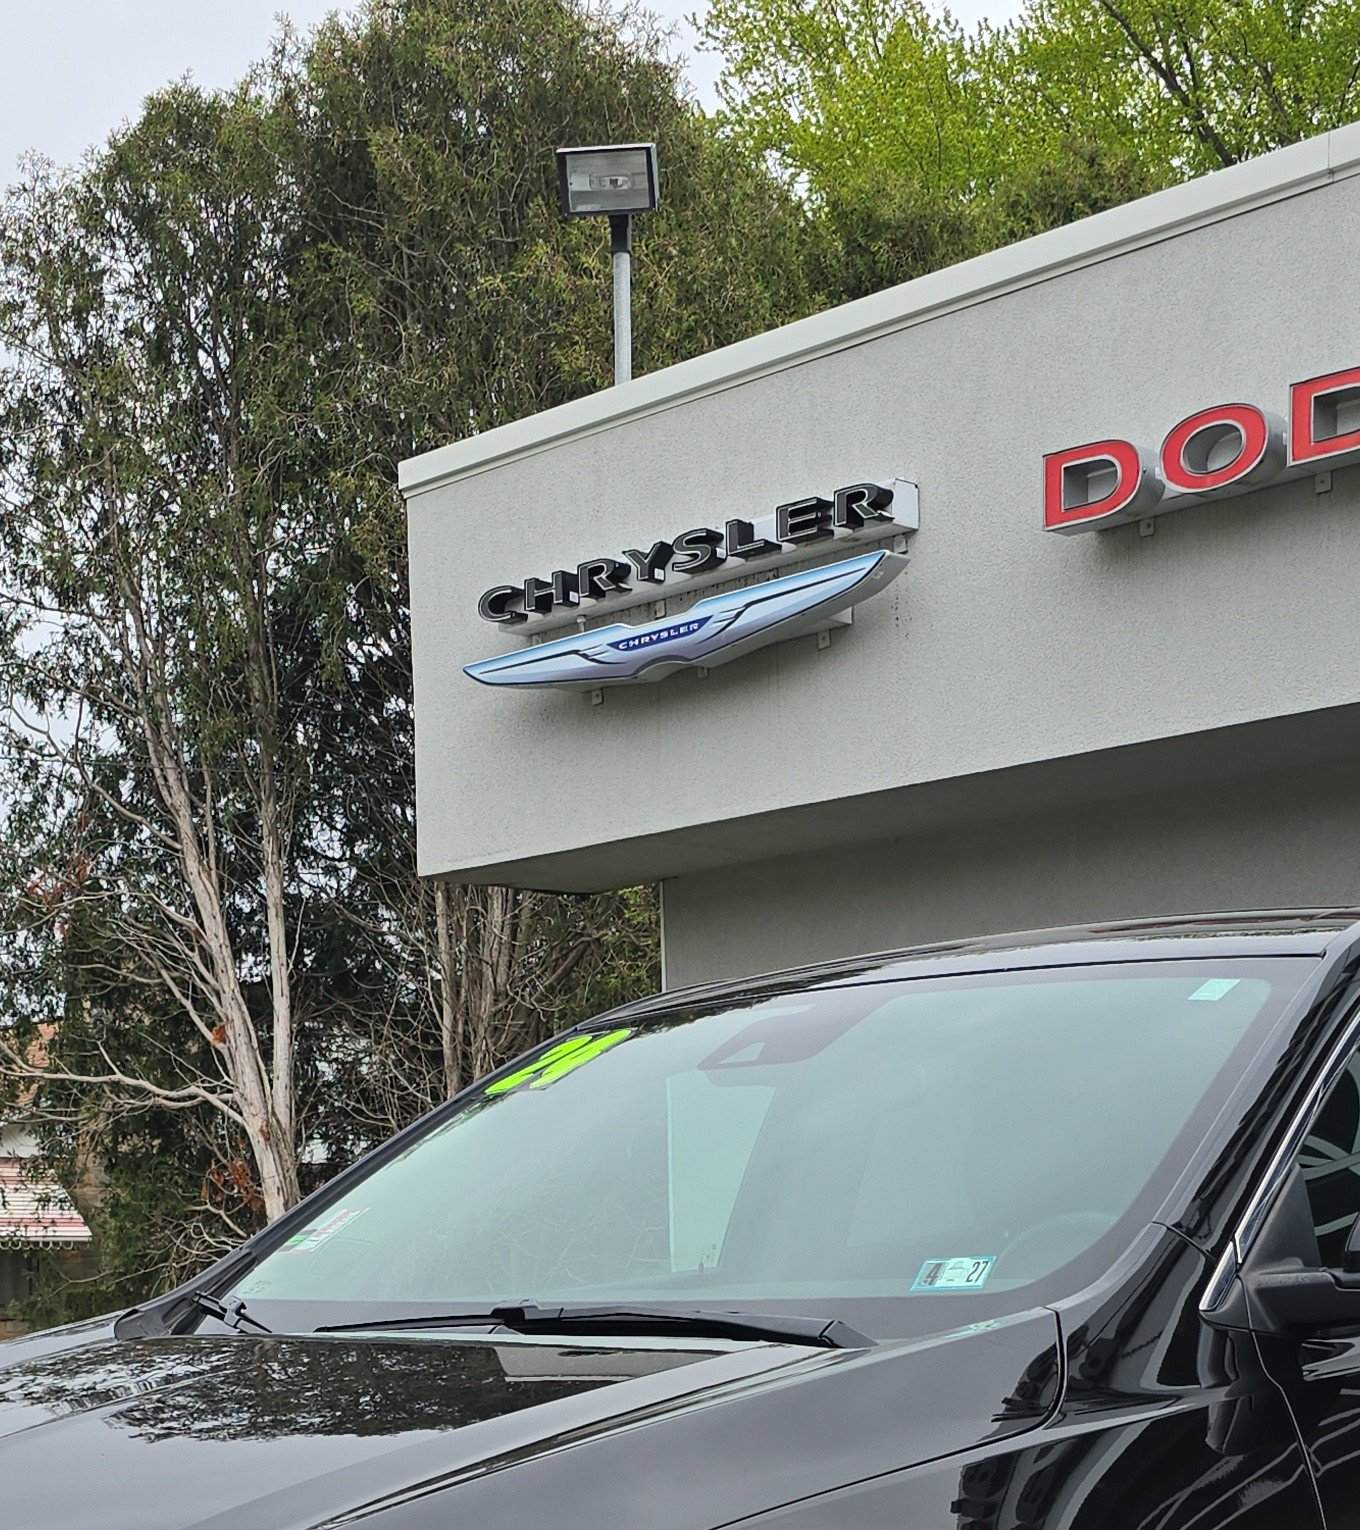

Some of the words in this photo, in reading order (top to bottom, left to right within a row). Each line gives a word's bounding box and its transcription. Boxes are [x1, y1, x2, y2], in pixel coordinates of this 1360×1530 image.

[478, 482, 894, 624] CHRYSLER
[618, 622, 700, 650] CHRYSLER
[965, 1260, 989, 1284] 27
